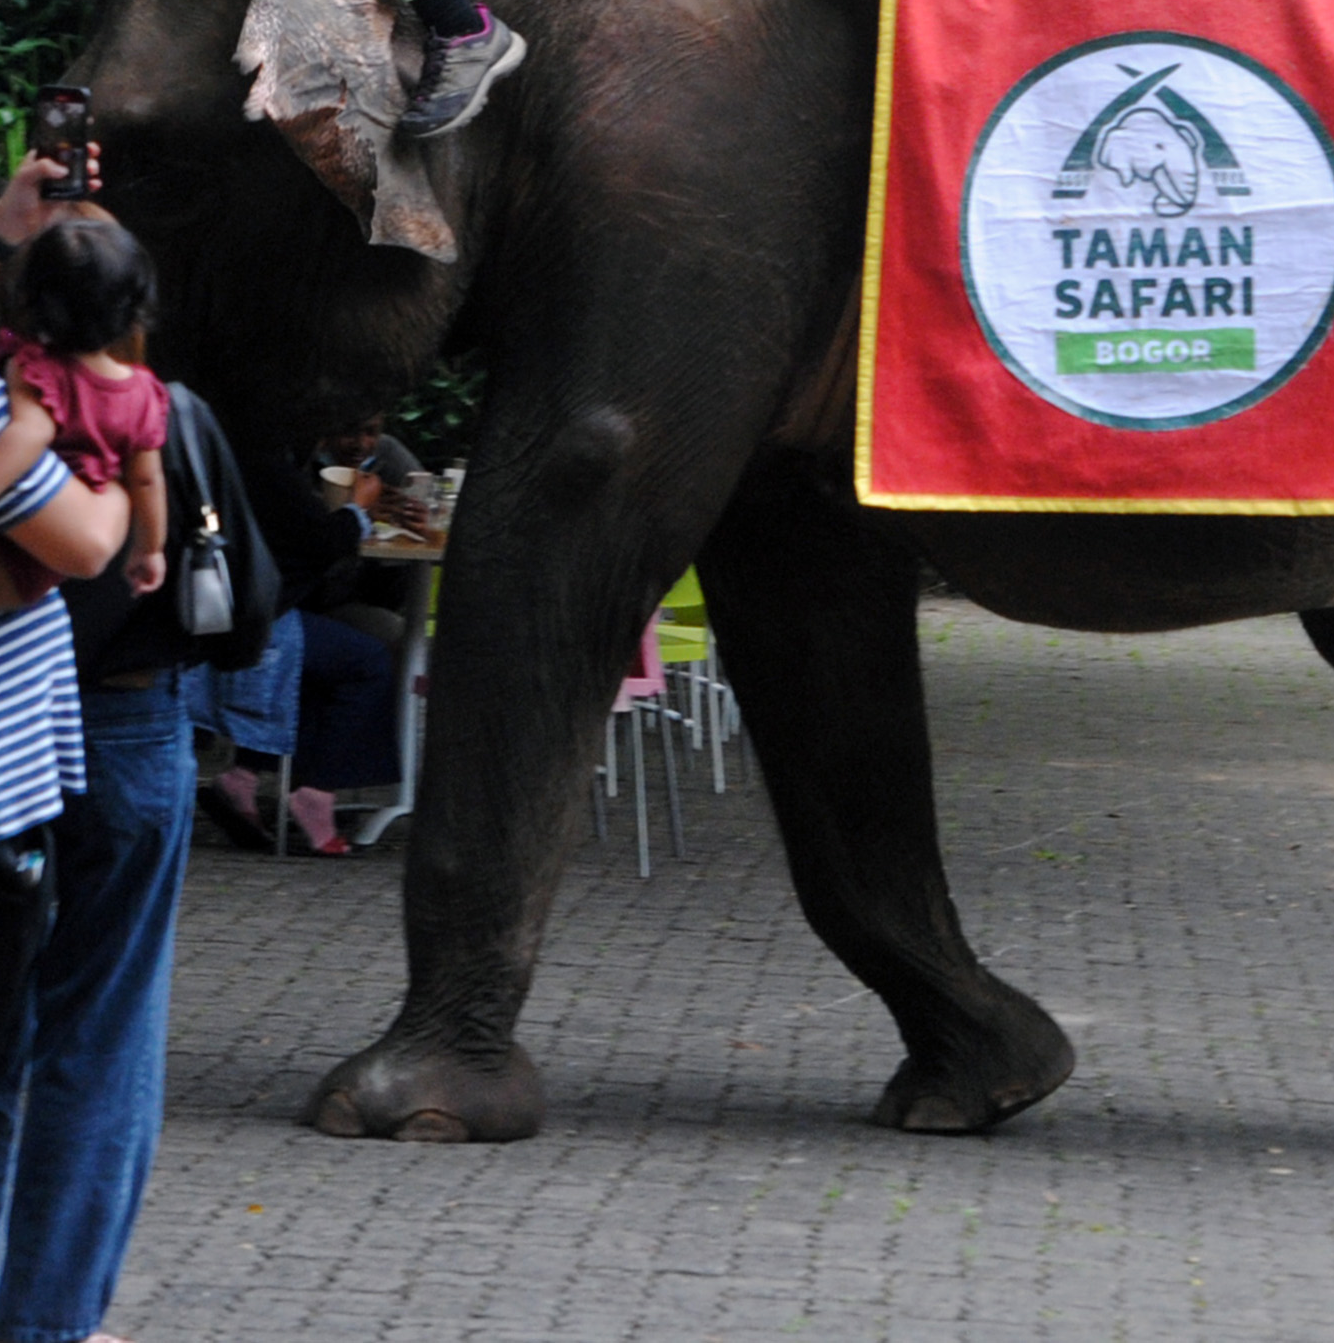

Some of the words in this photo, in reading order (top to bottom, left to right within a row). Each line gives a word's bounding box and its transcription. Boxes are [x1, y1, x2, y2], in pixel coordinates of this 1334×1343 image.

[1053, 226, 1253, 269] TAMAN
[1054, 277, 1254, 319] SAFARI
[1095, 339, 1212, 365] BOGOR
